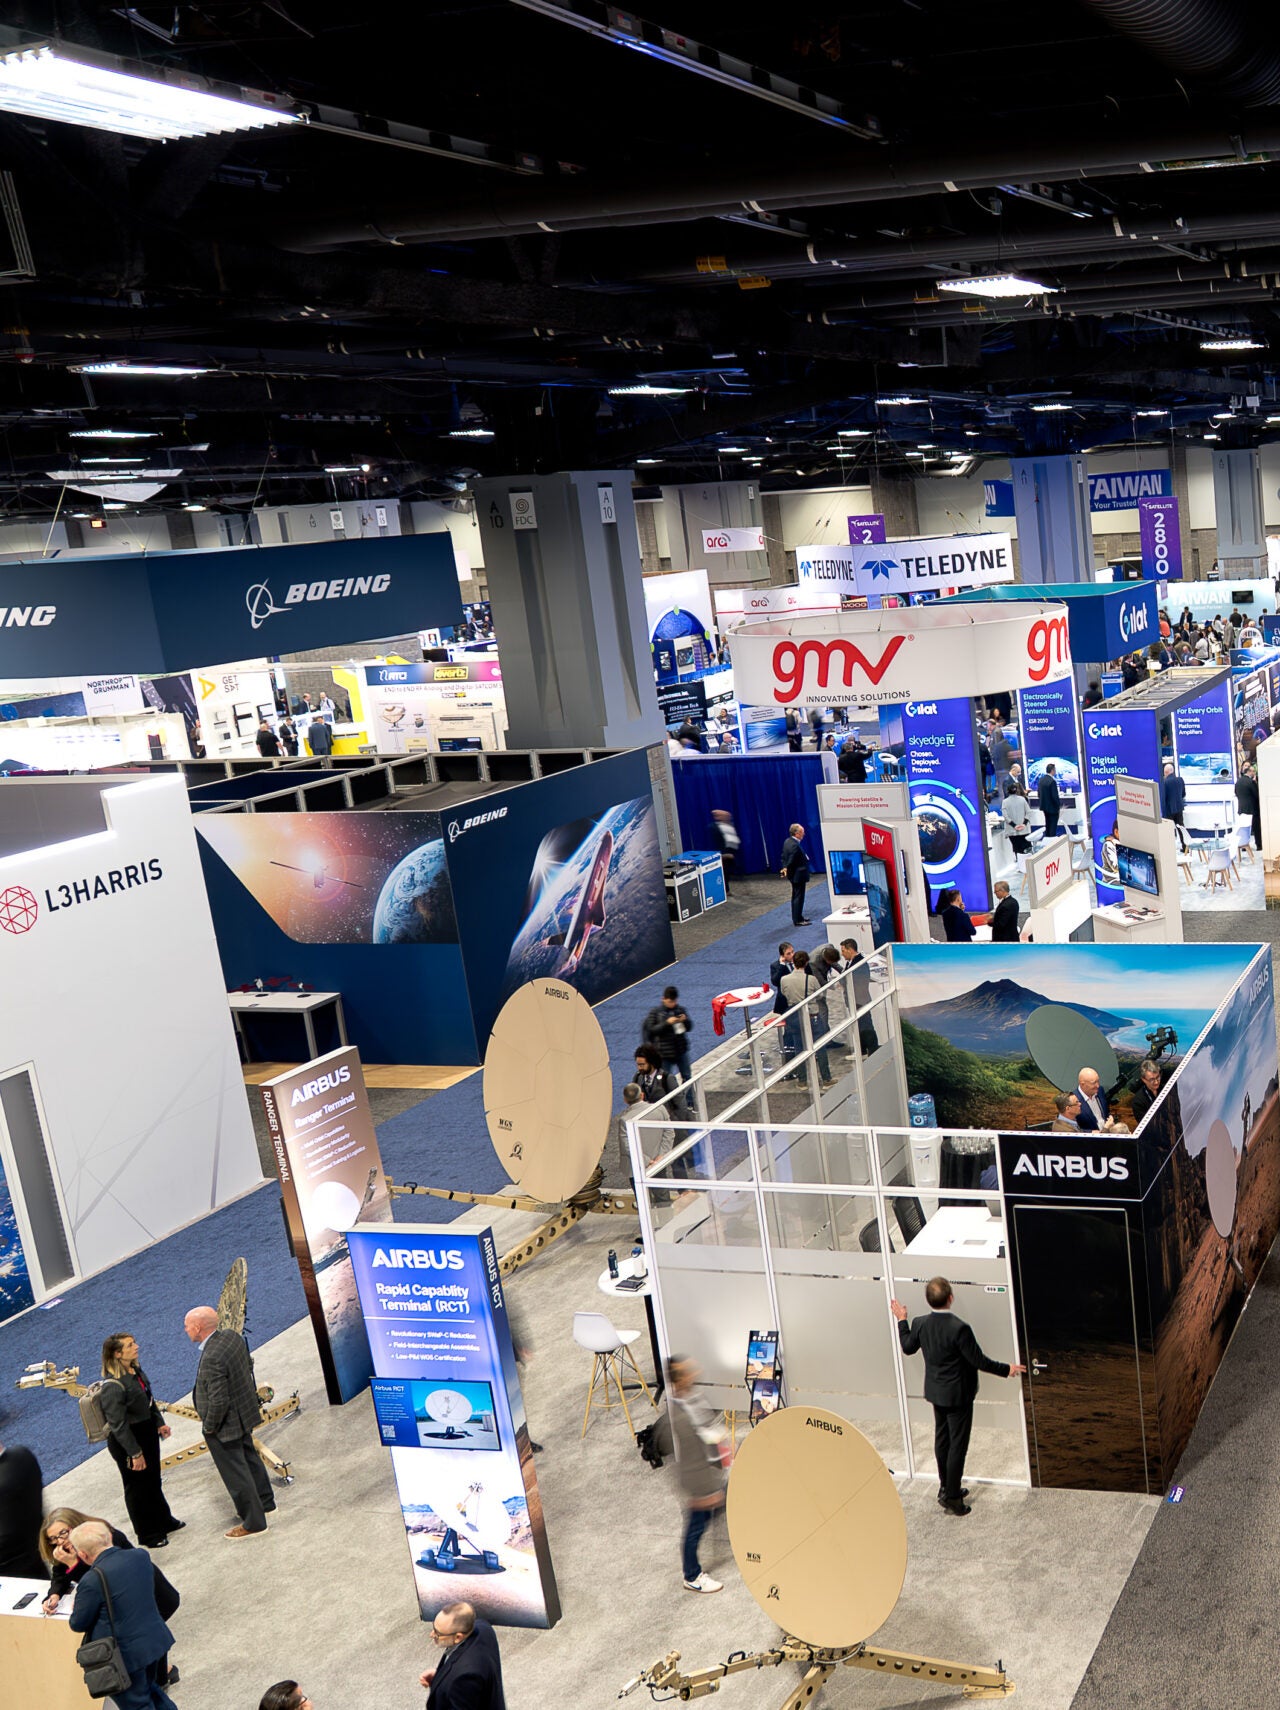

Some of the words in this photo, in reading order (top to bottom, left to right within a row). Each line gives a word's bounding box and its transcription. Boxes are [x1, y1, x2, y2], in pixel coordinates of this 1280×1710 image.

[516, 517, 533, 525] FDC
[603, 507, 612, 519] 10
[490, 516, 503, 528] 10
[812, 560, 854, 581] TELEDYNE
[901, 548, 1007, 578] TELEDYNE
[285, 574, 391, 604] BOEING
[1119, 602, 1148, 642] Gilat
[773, 636, 906, 703] gmv
[87, 678, 122, 689] NORTHROP
[223, 675, 237, 684] GET
[94, 683, 129, 695] GRUMMAN
[806, 694, 858, 703] INNOVATING
[861, 690, 911, 701] SOLUTIONS
[905, 701, 937, 717] Gilat
[1088, 723, 1123, 740] Gilat
[910, 750, 933, 758] Chosen.
[911, 758, 941, 767] Deployed.
[1091, 756, 1117, 766] Digital
[1092, 766, 1128, 774] Inclusion
[464, 807, 508, 830] BOEING
[1045, 857, 1060, 885] gmv
[45, 859, 163, 912] L3HARRIS
[545, 987, 569, 1000] AIRBUS
[291, 1065, 350, 1107] AIRBUS
[294, 1109, 323, 1129] Ranger
[323, 1092, 356, 1114] Terminal
[263, 1091, 279, 1132] RANGER
[273, 1135, 290, 1183] TERMINAL
[1013, 1154, 1129, 1180] AIRBUS
[372, 1248, 465, 1270] AIRBUS
[483, 1236, 498, 1281] AIRBUS
[491, 1285, 503, 1309] RCT
[376, 1283, 410, 1297] Rapid
[379, 1299, 432, 1311] Terminal
[436, 1300, 470, 1314] (RCT)
[806, 1417, 843, 1435] AIRBUS
